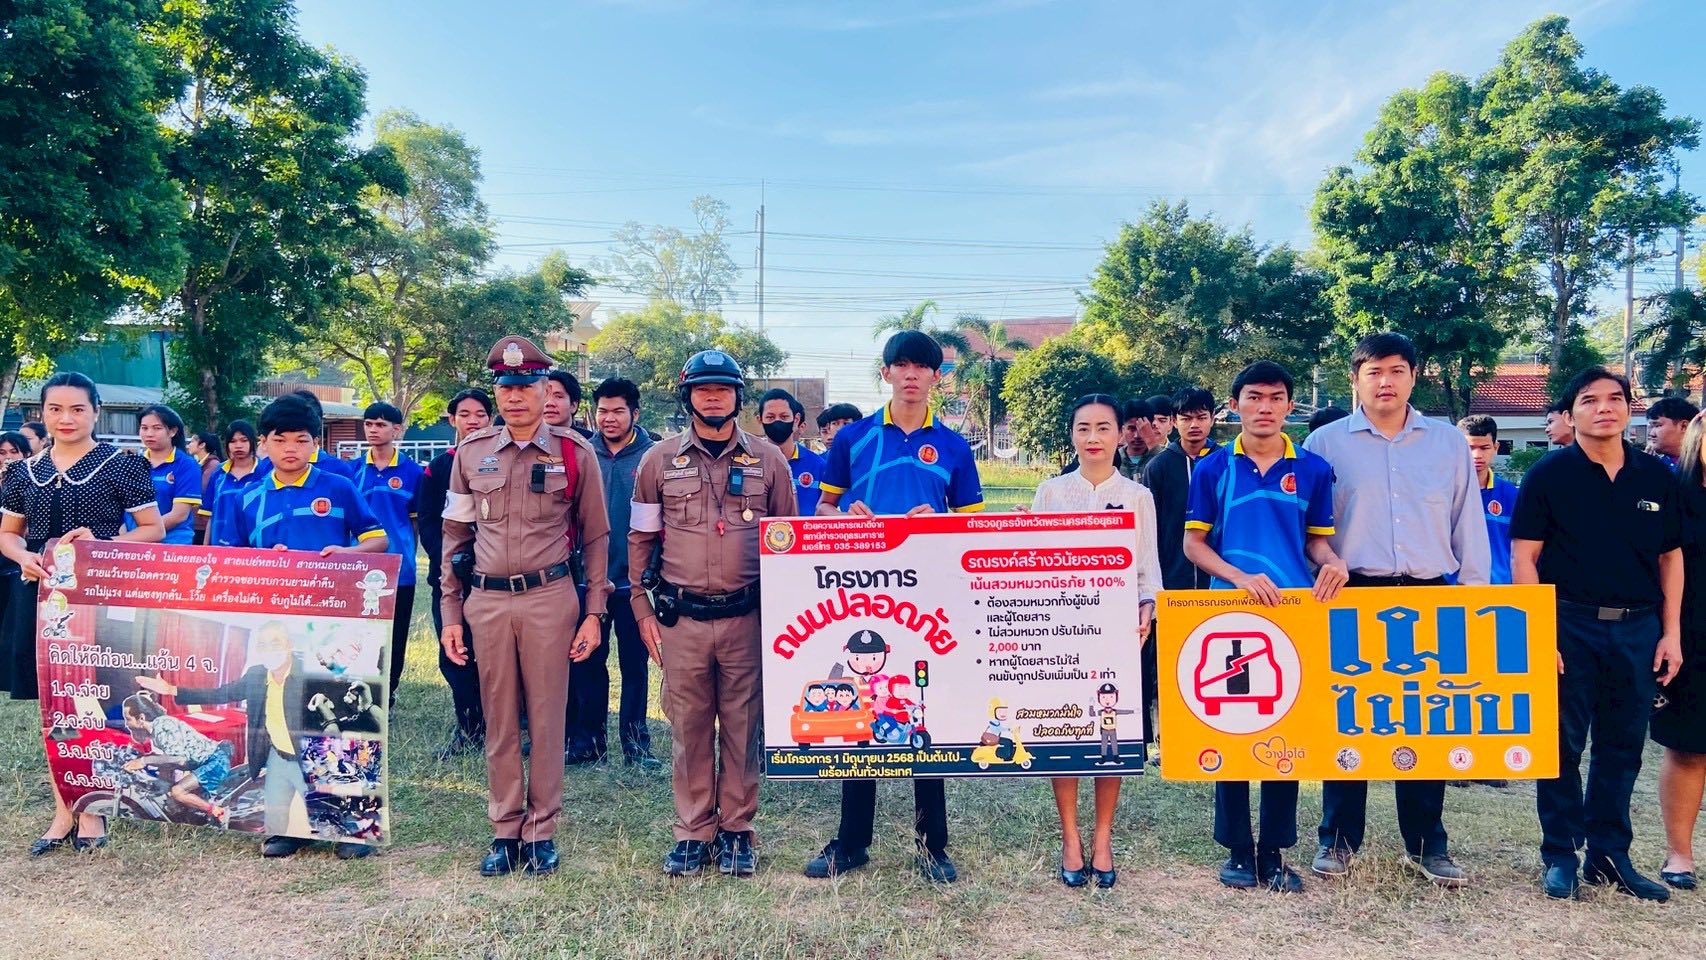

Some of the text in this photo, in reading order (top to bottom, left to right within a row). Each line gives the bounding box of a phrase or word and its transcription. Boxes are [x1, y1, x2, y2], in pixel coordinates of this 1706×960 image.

[967, 516, 1123, 530] ตำรวจภูธรจังหวัดพระนครศรีอยุธยา
[834, 541, 886, 550] 035-389153
[968, 550, 1125, 569] รณรงค์สร้างวินัยจราจร
[814, 566, 918, 588] โครงการ
[970, 575, 1125, 590] เน้นสวมหมวกนิรภัย 100%
[987, 590, 1101, 610] ต้องสวมหมวกทั้งผู้ขับขี่
[773, 588, 958, 660] ถนนปลอดภัย
[986, 611, 1051, 626] และผู้โดยสาร
[988, 625, 1102, 637] ไม่สวมหมวก ปรับไม่เกิน
[988, 642, 1042, 653] 2,000 บาท
[1328, 605, 1528, 676] เมา
[186, 655, 196, 671] 4
[202, 657, 218, 673] จ.
[988, 653, 1080, 670] หากผู้โดยสารไม่ใส่
[988, 667, 1116, 685] คนขับถูกปรับเพิ่มเป็น 2 เท่า
[51, 679, 111, 699] 1.จ.จ่าย
[1016, 703, 1083, 720] สวมหมวกมั่นใจ
[1330, 679, 1531, 736] ไม่ขับ
[53, 710, 105, 730] 2.จ.จับ
[1033, 721, 1095, 740] ปลอดภัยทุกที่
[57, 741, 114, 760] 3.จ.เจ็บ
[771, 749, 960, 767] เริ่มโครงการ 1 มิถุนายน 2568 เป็นต้นไป
[818, 764, 913, 778] พร้อมกันทั่วประเทศ
